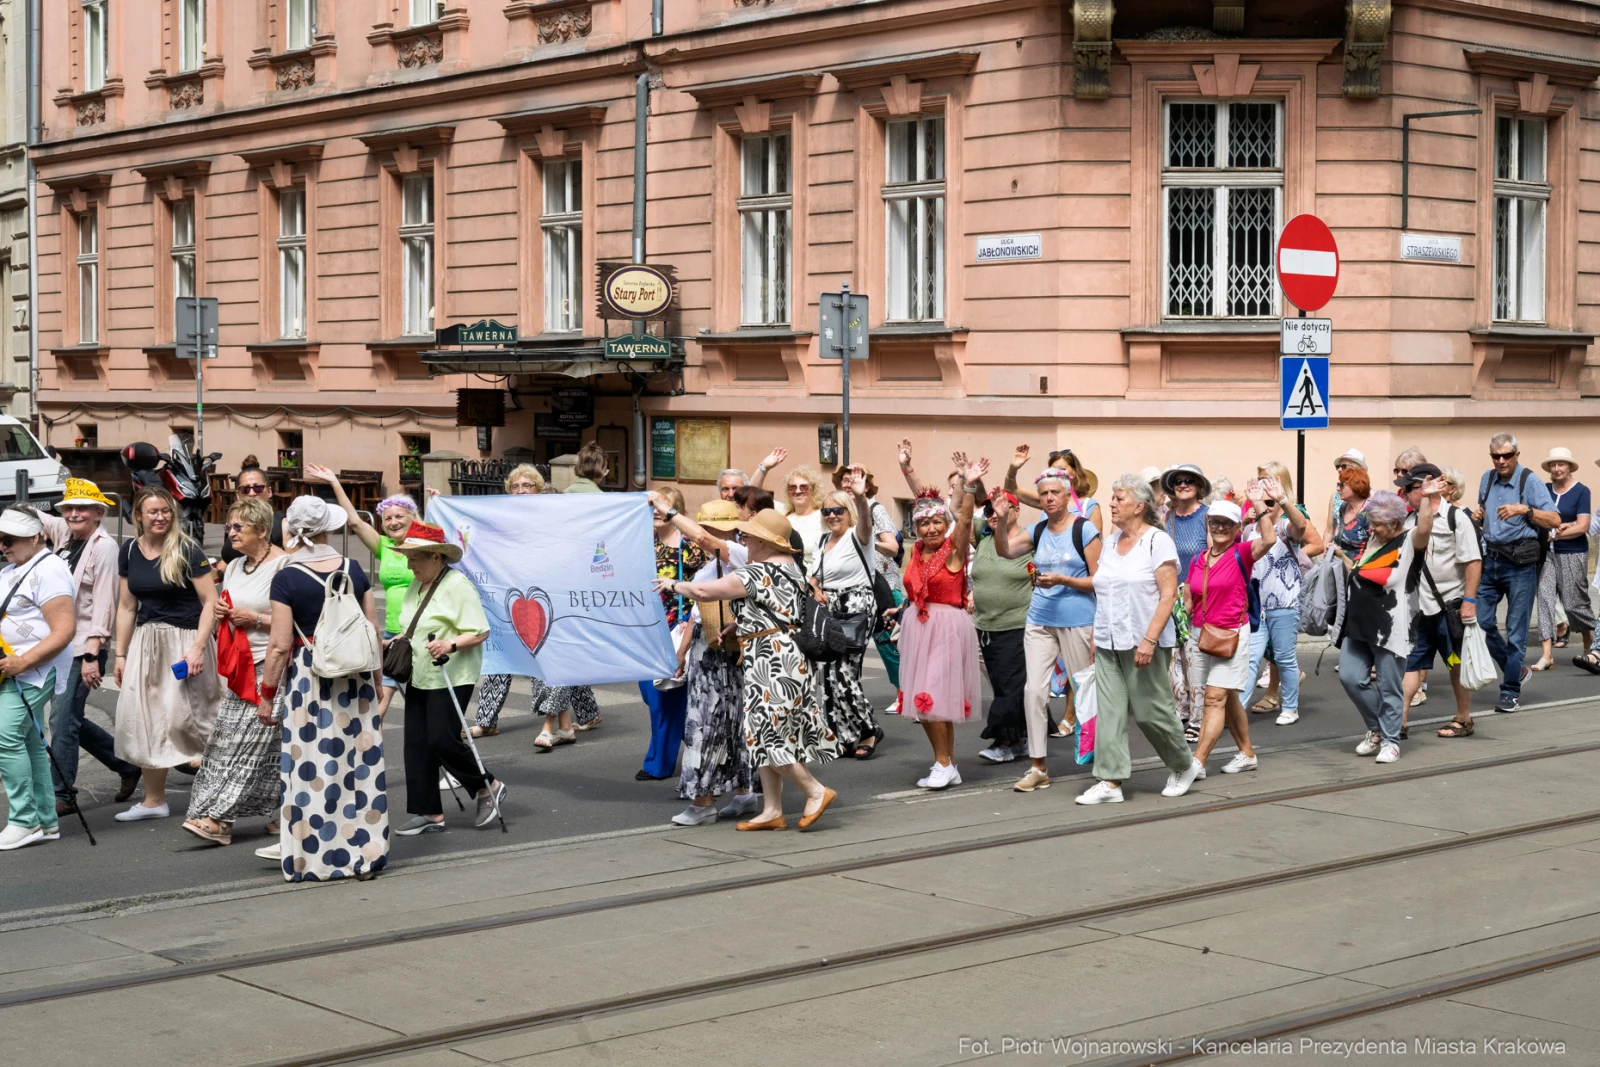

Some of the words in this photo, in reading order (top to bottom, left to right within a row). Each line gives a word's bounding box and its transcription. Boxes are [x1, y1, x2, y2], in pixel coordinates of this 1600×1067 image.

[978, 245, 1039, 258] JABŁONOWSKICH
[1407, 245, 1458, 259] STRASZEWSKIEGO
[614, 287, 637, 303] Stary
[638, 287, 655, 300] Port
[1285, 321, 1299, 331] Nie
[1301, 321, 1330, 333] dotyczy
[462, 331, 513, 341] TAWERNA
[609, 343, 667, 354] TAWERNA
[569, 590, 645, 612] BĘDZIN
